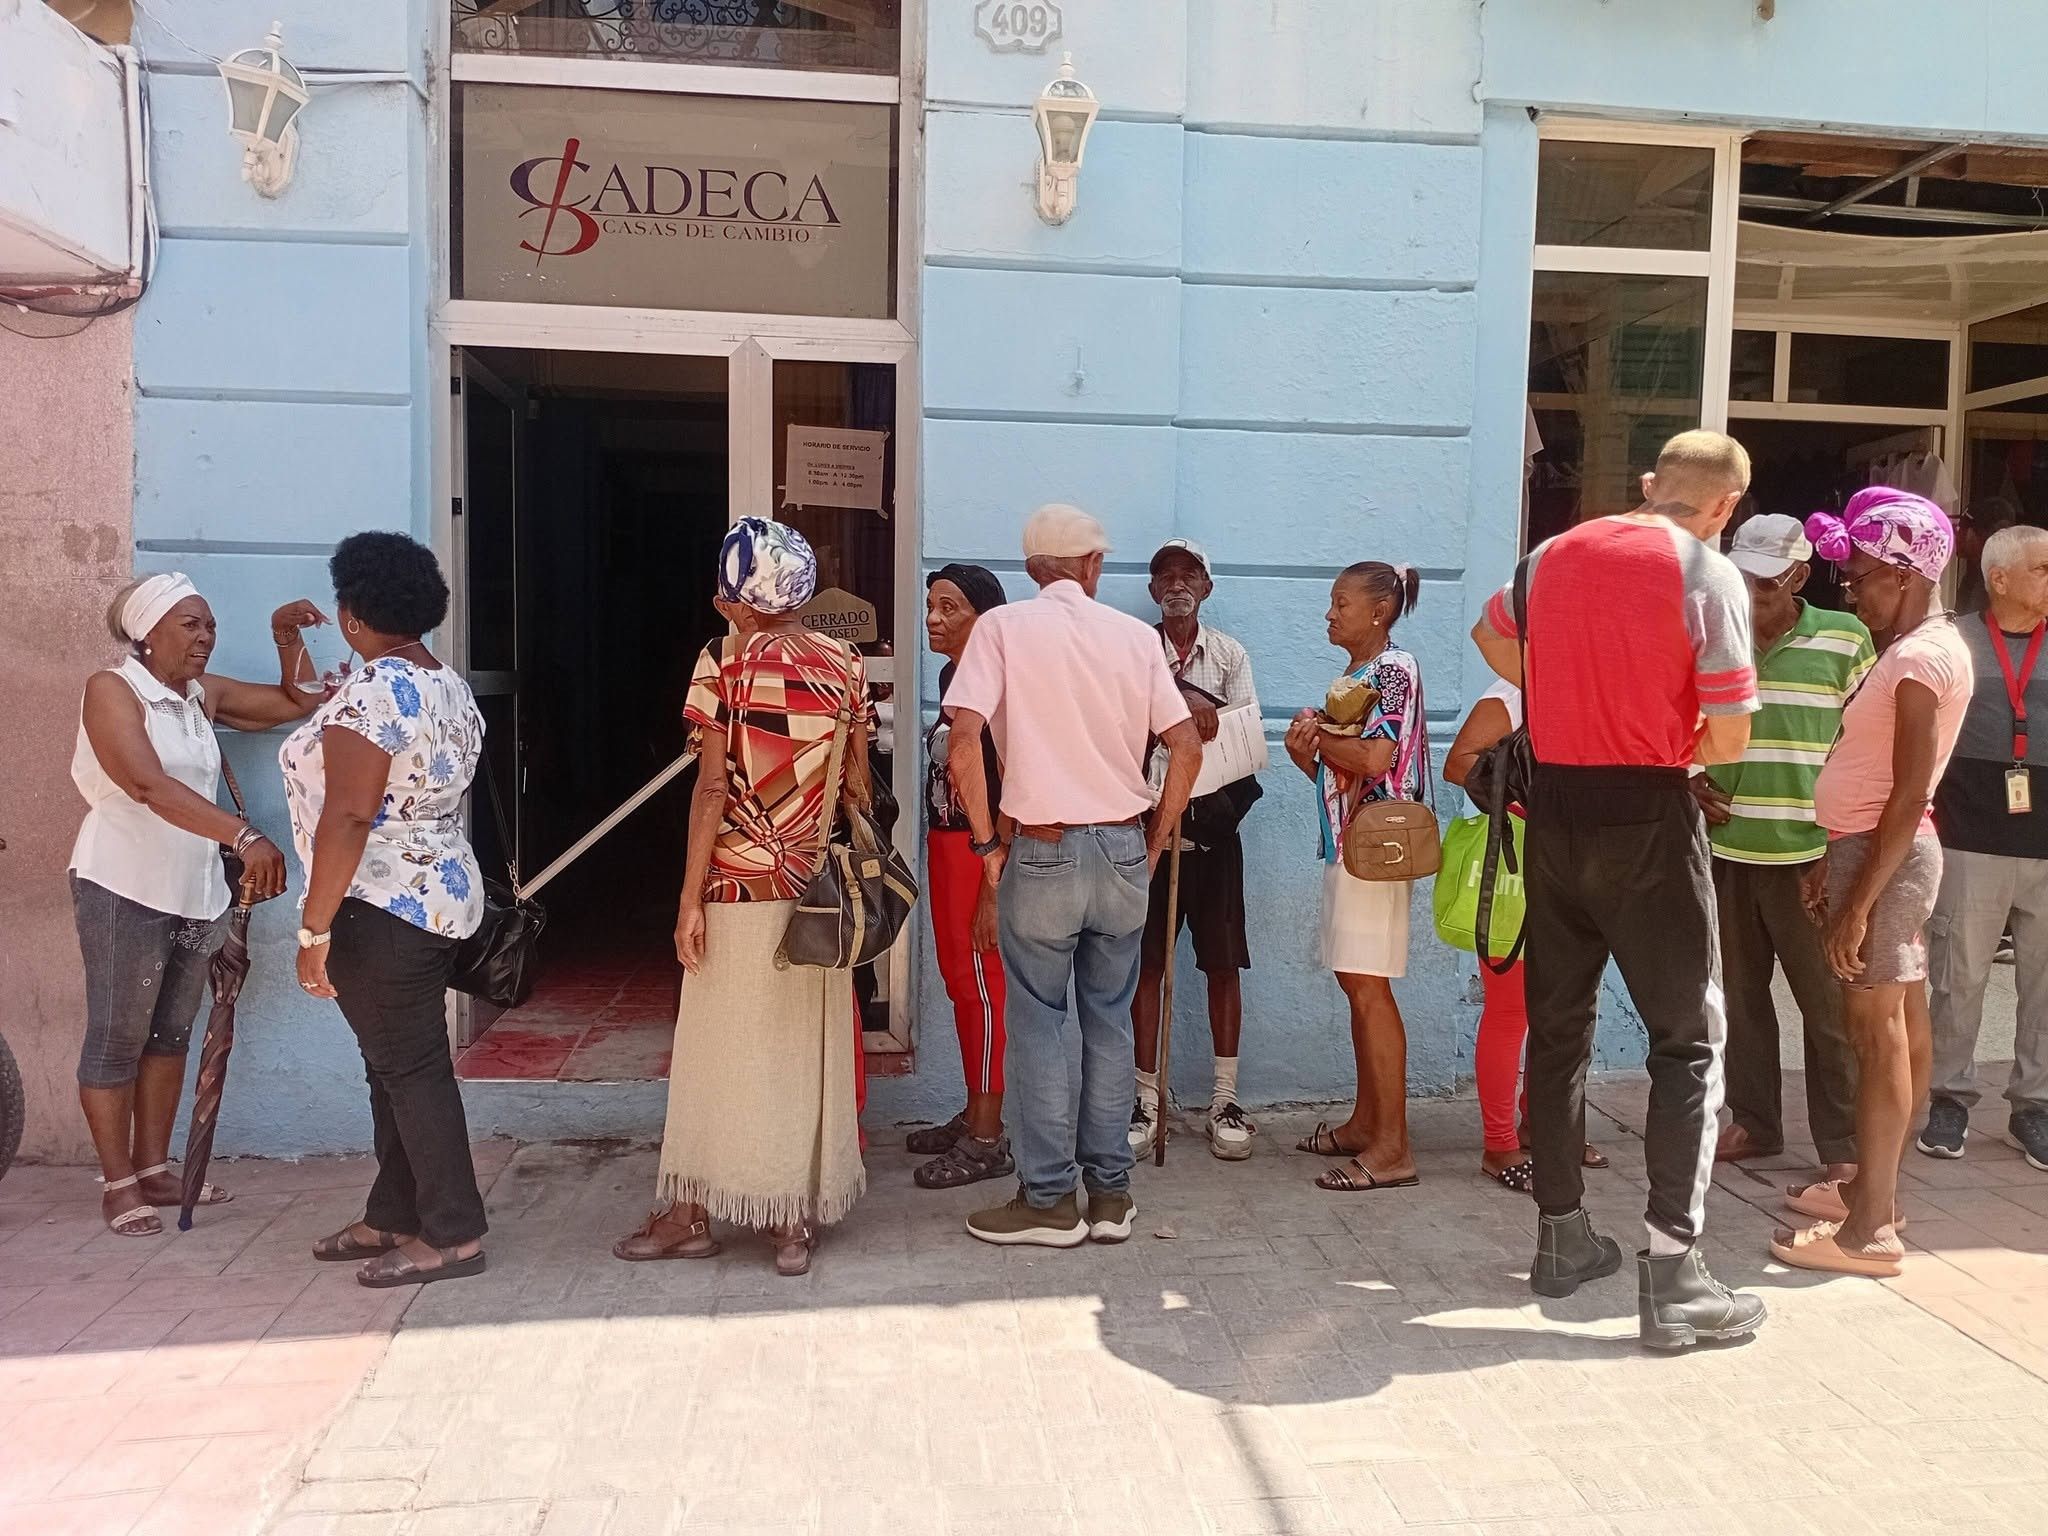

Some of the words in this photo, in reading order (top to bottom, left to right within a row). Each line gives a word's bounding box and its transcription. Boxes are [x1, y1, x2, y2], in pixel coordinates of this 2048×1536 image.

[992, 4, 1047, 37] 409
[510, 156, 841, 225] CADECA
[602, 219, 678, 238] CASAS
[686, 222, 716, 239] DE
[723, 225, 810, 244] CAMBIO
[802, 441, 832, 449] HORARIO
[842, 444, 871, 452] SERVICIO
[801, 610, 870, 628] CERRADO
